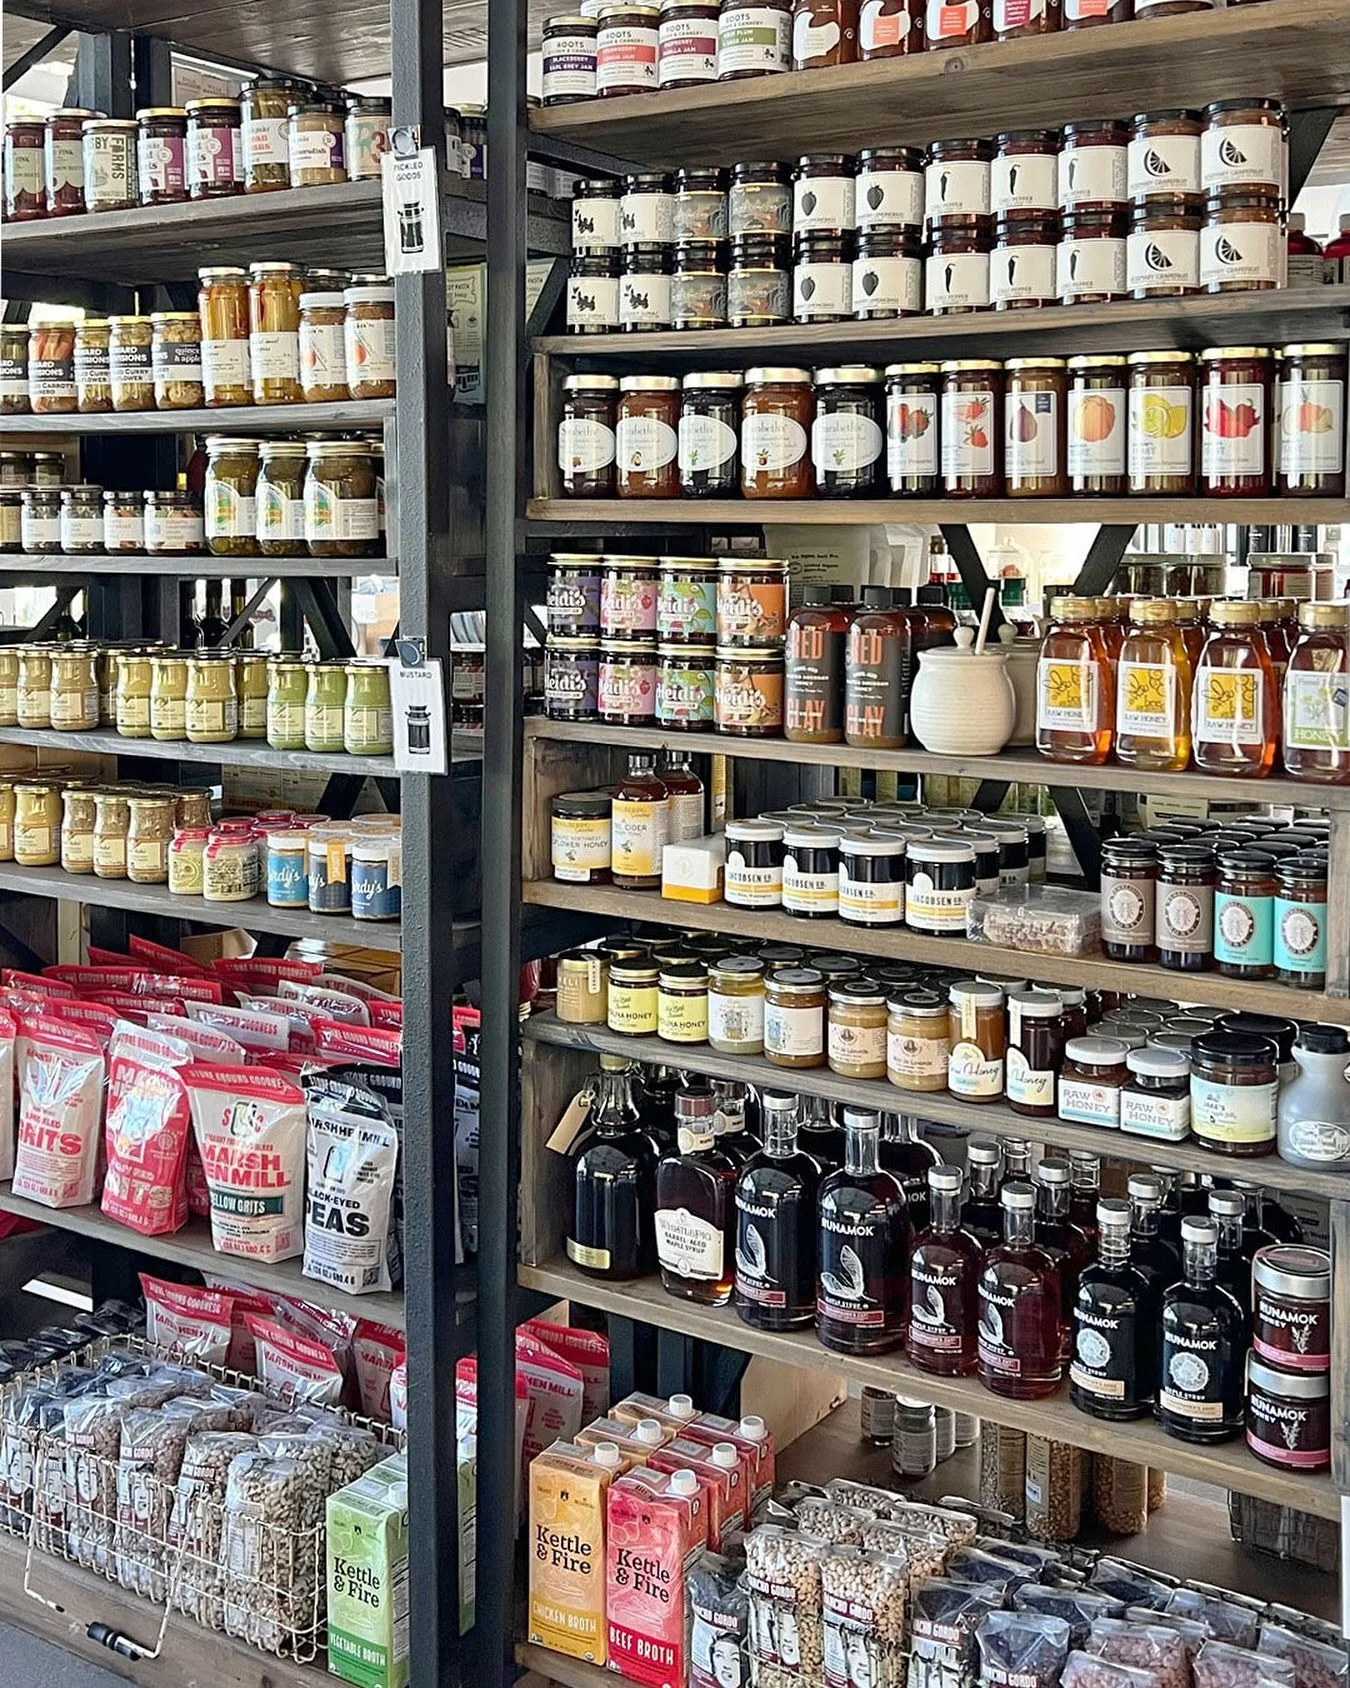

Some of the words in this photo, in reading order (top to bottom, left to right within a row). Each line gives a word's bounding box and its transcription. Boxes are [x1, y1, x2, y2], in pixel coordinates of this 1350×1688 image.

[394, 162, 424, 171] PICKLED
[396, 171, 422, 182] GOODS
[792, 630, 822, 660] RED
[852, 634, 882, 665] RED
[400, 671, 432, 679] MUSTARD
[1140, 715, 1167, 723] HONEY
[624, 824, 647, 832] CIDER
[584, 841, 608, 849] HONEY
[240, 1016, 278, 1035] GOODNESS
[626, 1012, 652, 1020] HONEY
[189, 1070, 214, 1081] STONE
[216, 1072, 247, 1084] GROUND
[369, 1074, 401, 1089] GROUND
[964, 1062, 1000, 1082] Honey
[1063, 1088, 1091, 1101] RAW
[1066, 1098, 1111, 1113] HONEY
[1126, 1100, 1154, 1114] RAW
[1129, 1110, 1175, 1127] HONEY
[202, 1142, 281, 1171] MARSH
[230, 1166, 292, 1188] MILL
[237, 1199, 266, 1215] GRITS
[821, 1217, 874, 1237] RUNAMOK
[1260, 1300, 1320, 1325] RUNAMOK
[264, 1350, 294, 1371] MARSH
[550, 1383, 575, 1398] MILL
[1250, 1394, 1309, 1422] RUNAMOK
[134, 1448, 154, 1458] GORDO
[536, 1524, 592, 1557] Kettle
[536, 1544, 549, 1562] &
[551, 1550, 592, 1576] Fire
[616, 1548, 671, 1585] Kettle
[334, 1556, 381, 1590] Kettle
[334, 1574, 346, 1593] &
[348, 1580, 380, 1608] Fire
[616, 1568, 630, 1586] &
[632, 1575, 670, 1604] Fire
[770, 1584, 796, 1600] GORDO
[534, 1604, 566, 1627] CHICKEN
[567, 1613, 597, 1634] BROTH
[714, 1611, 738, 1628] GORDO
[932, 1622, 960, 1641] GORDO
[330, 1632, 362, 1659] VEGETABLE
[362, 1644, 386, 1667] BROTH
[610, 1626, 632, 1652] BEEF
[636, 1636, 675, 1666] BROTH
[1008, 1673, 1036, 1688] GORDO
